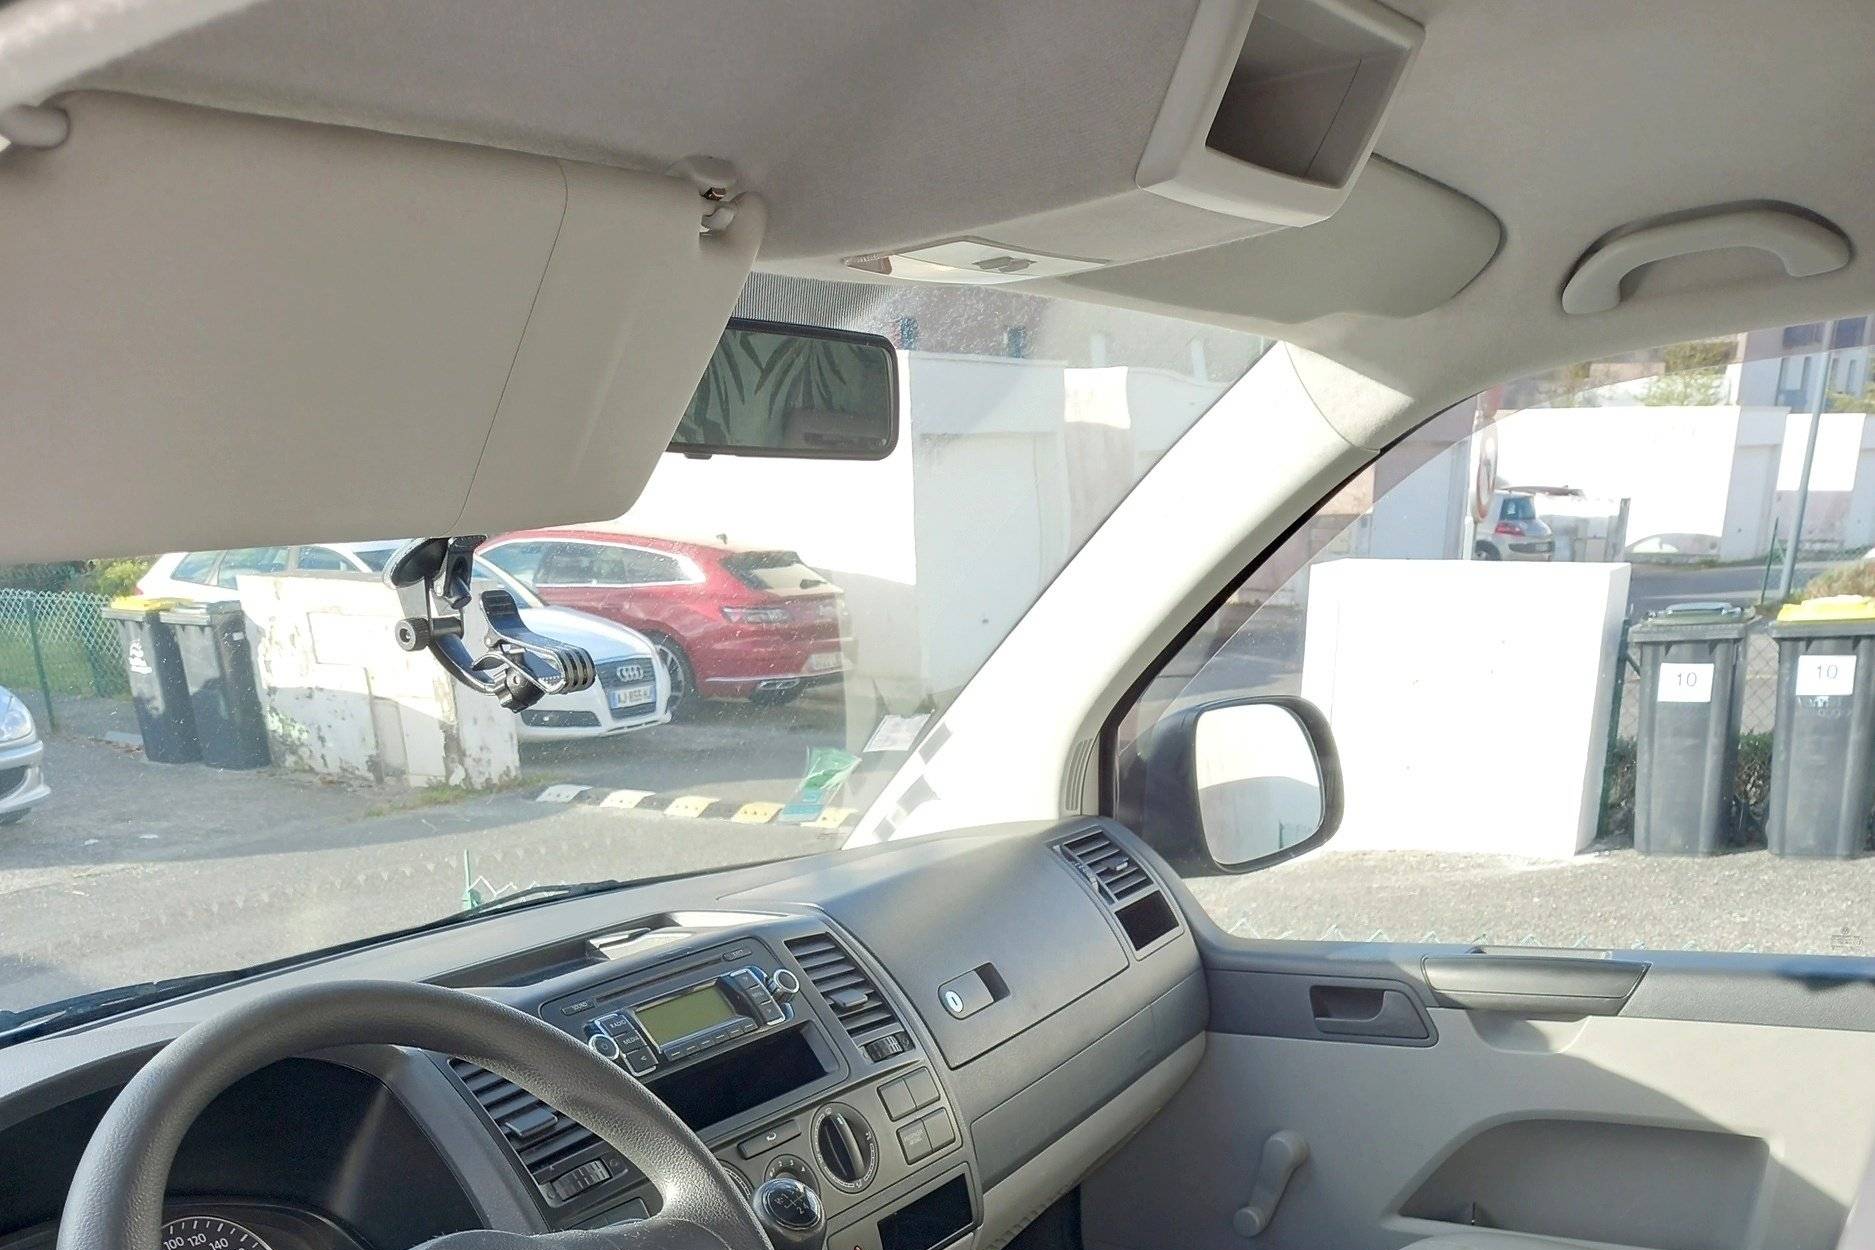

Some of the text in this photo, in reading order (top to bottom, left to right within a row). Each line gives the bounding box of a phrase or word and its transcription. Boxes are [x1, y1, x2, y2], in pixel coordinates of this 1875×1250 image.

[1676, 671, 1698, 687] 10
[1816, 664, 1839, 680] 10
[164, 1236, 185, 1250] 100
[187, 1233, 207, 1248] 120
[208, 1237, 229, 1250] 140
